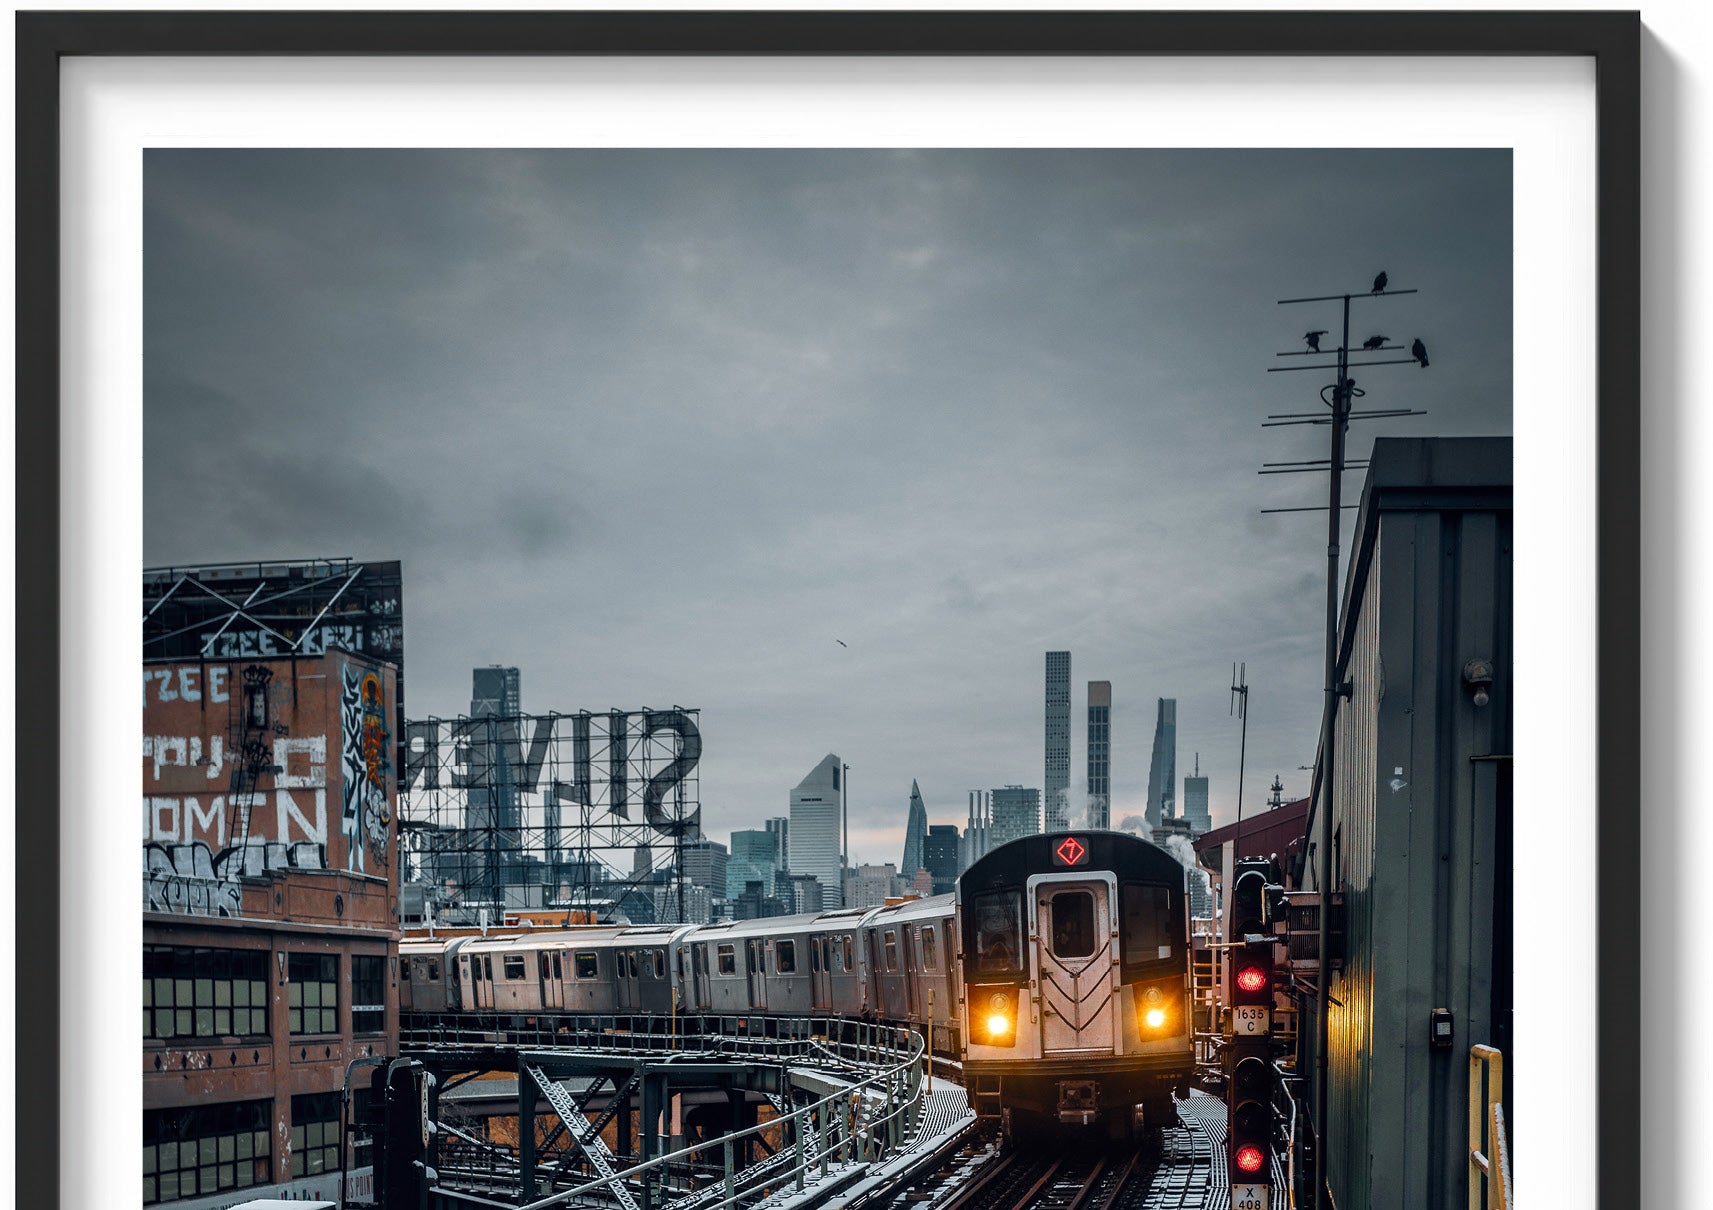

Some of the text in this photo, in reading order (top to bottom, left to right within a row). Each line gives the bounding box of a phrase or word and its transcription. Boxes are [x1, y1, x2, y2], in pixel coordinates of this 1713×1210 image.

[143, 788, 327, 847] OMIN
[1238, 1008, 1264, 1020] 1635
[1247, 1021, 1255, 1032] C
[338, 1178, 354, 1200] OUS
[1246, 1187, 1254, 1198] X
[1238, 1200, 1261, 1210] 408
